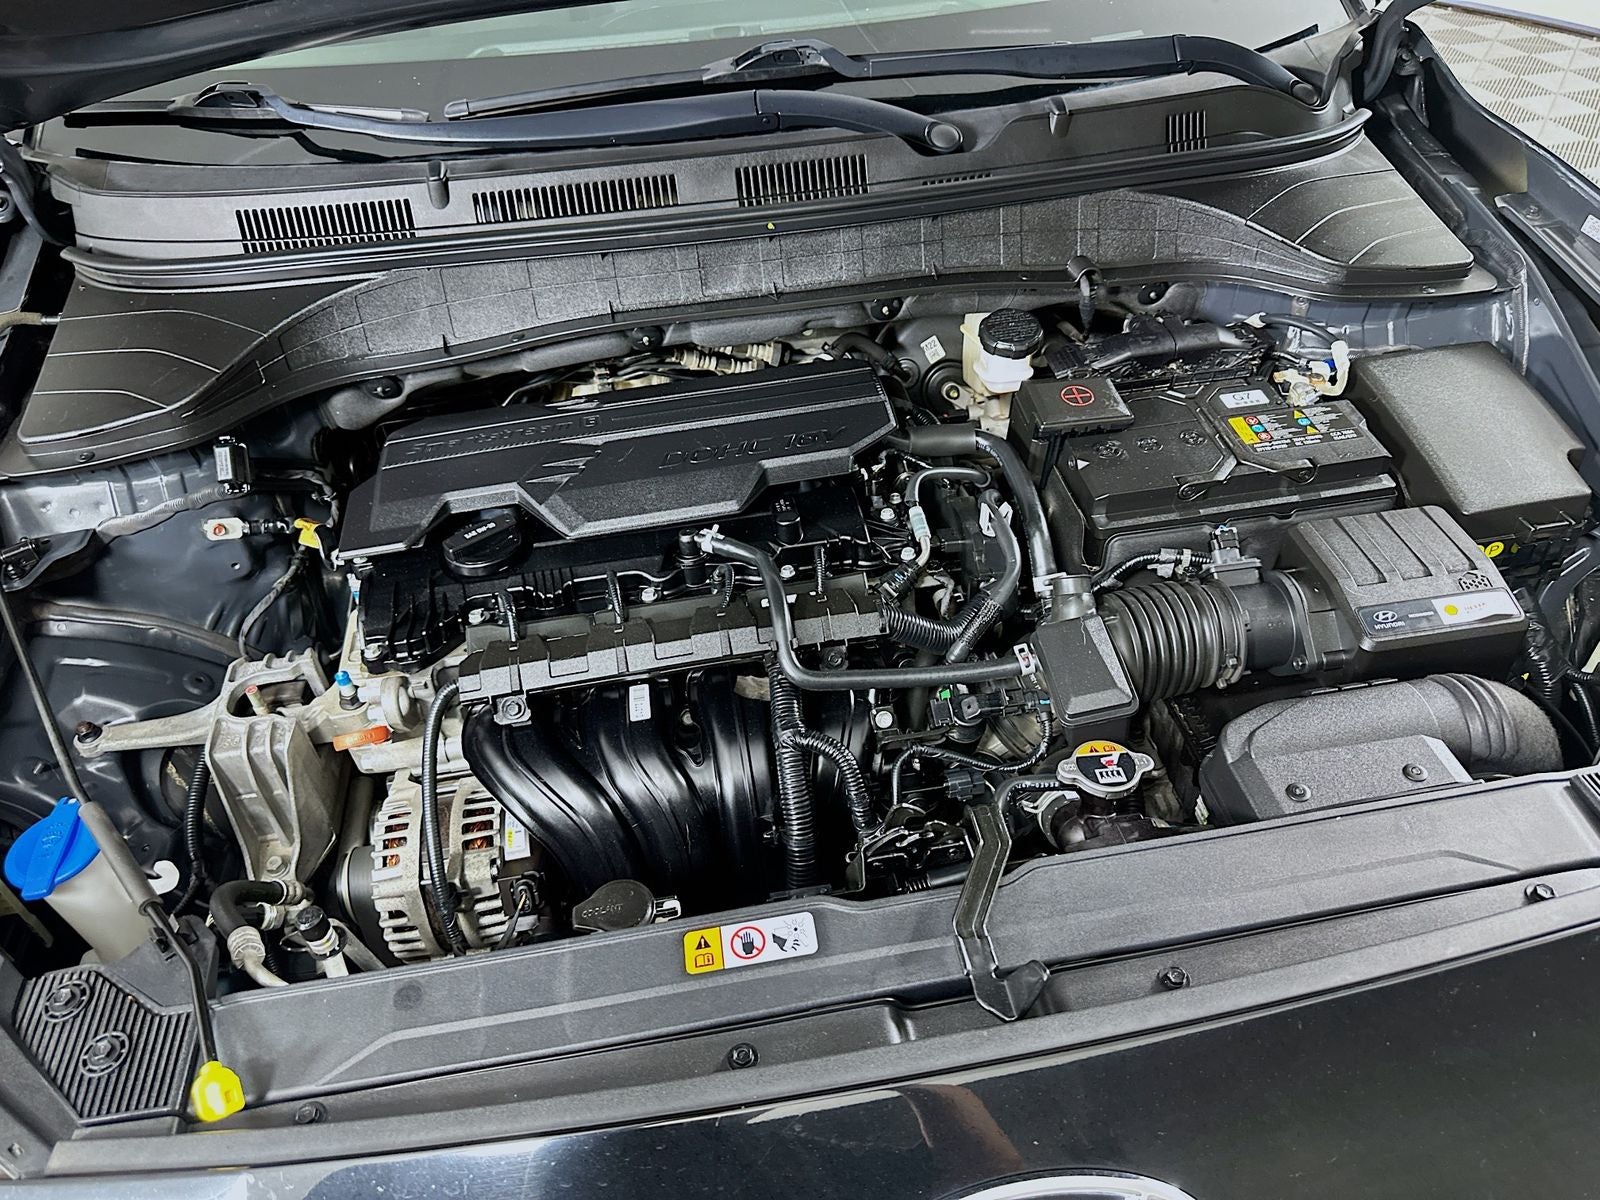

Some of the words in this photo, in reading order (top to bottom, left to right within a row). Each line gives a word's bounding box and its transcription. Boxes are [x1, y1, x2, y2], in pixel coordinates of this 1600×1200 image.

[1232, 392, 1250, 401] G7
[658, 437, 774, 470] DOHC
[783, 425, 848, 450] 16V
[1487, 543, 1500, 556] P
[1374, 620, 1406, 631] HYUNDAI
[581, 902, 625, 919] COOLANT
